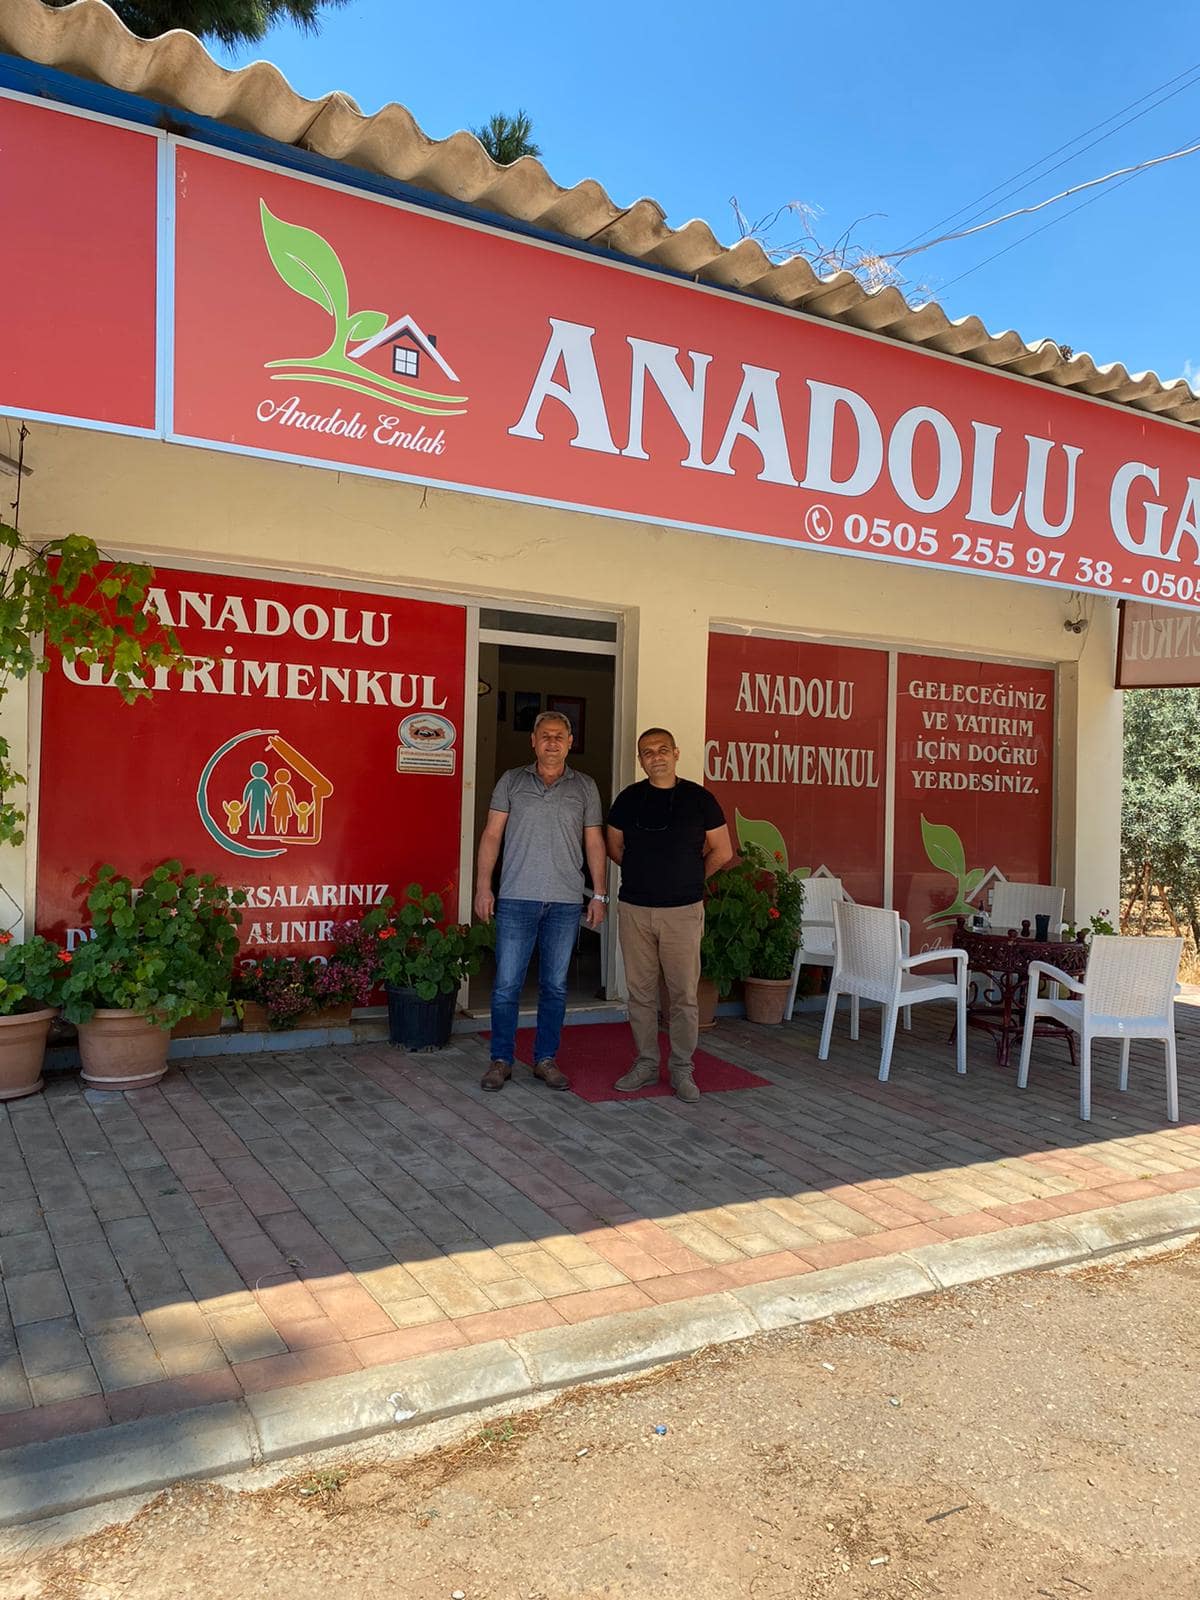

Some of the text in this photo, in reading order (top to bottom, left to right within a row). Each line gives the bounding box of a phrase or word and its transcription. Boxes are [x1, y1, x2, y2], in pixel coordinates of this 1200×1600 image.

[256, 396, 446, 455] Anadolu Emlak
[508, 317, 1084, 538] ANADOLU
[843, 513, 939, 556] 0505
[951, 533, 1015, 569] 255
[1025, 547, 1066, 578] 97
[1075, 557, 1114, 587] 38
[141, 587, 392, 647] ANADOLU
[735, 672, 855, 720] ANADOLU
[908, 680, 1048, 711] GELECEĞİNİZ
[916, 734, 1039, 766] İÇİN DOĞRU
[921, 711, 1034, 737] VE YATIRIM
[704, 730, 880, 788] GAYRİMENKUL
[911, 769, 1040, 794] YERDESİNİZ.
